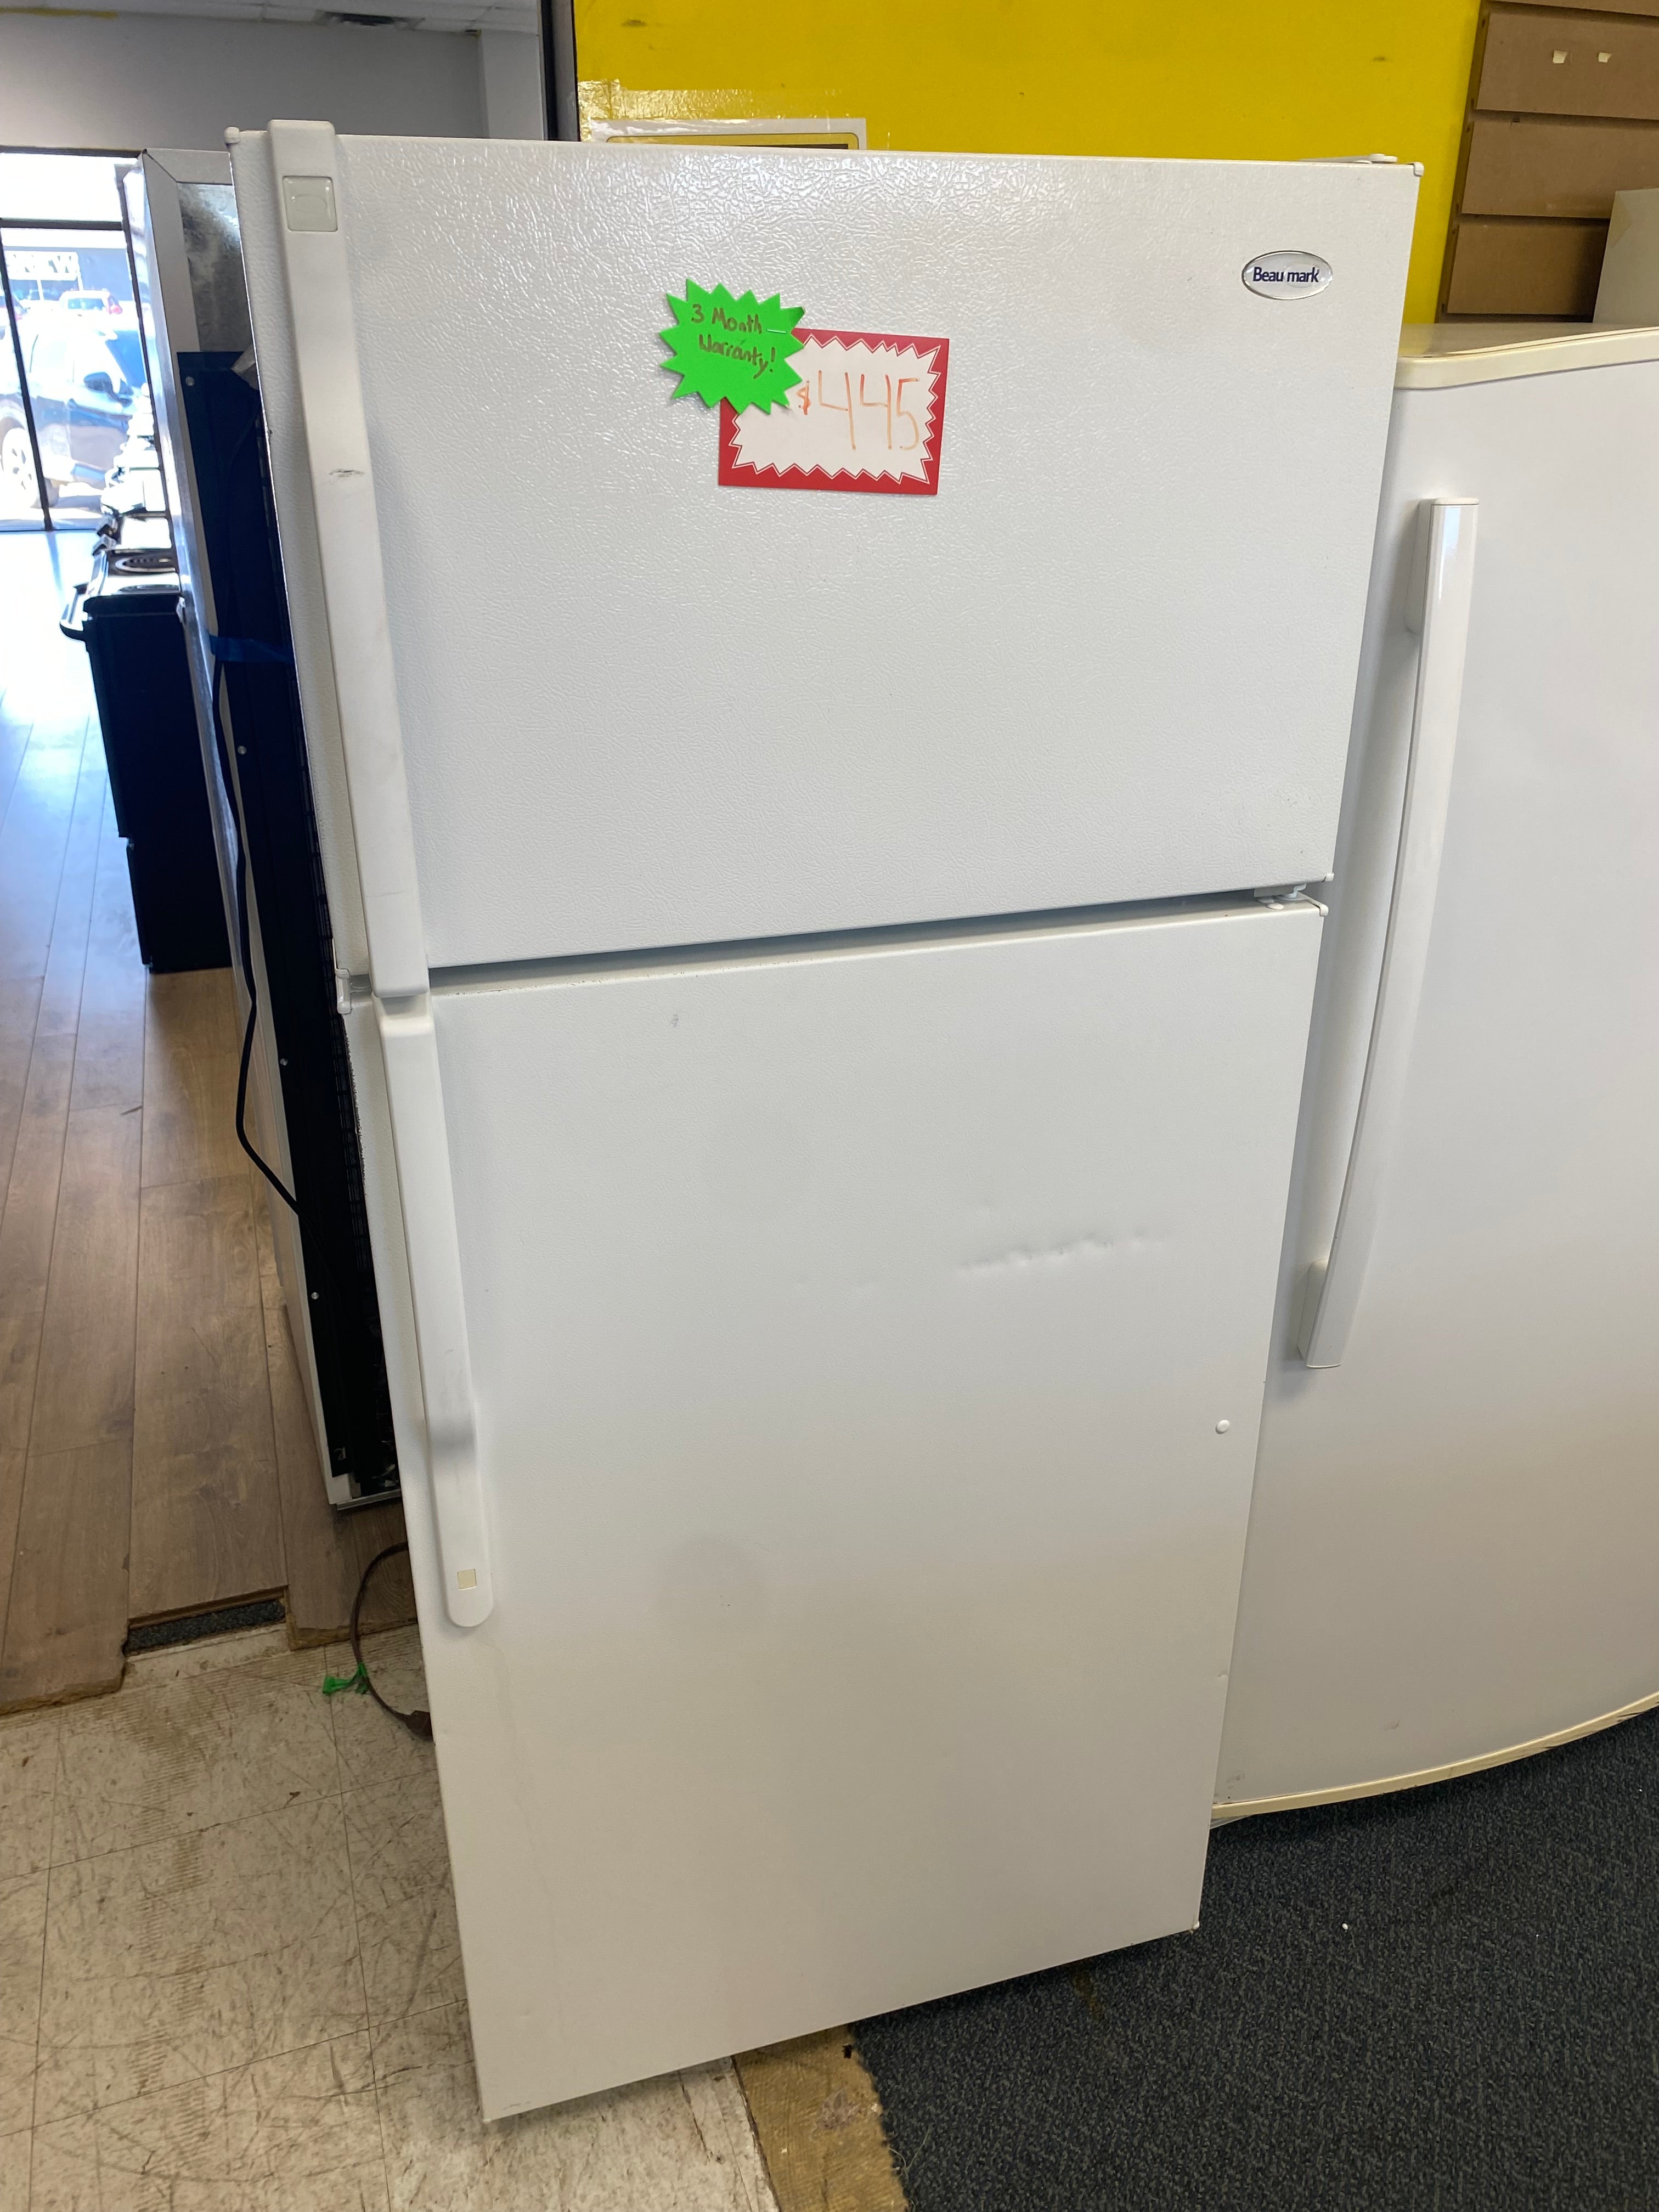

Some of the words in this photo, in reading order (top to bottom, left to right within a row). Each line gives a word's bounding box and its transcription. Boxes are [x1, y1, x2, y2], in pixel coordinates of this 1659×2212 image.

[1252, 267, 1284, 282] Beau
[1286, 267, 1319, 283] mark
[691, 303, 704, 323] 3
[712, 307, 762, 334] Month
